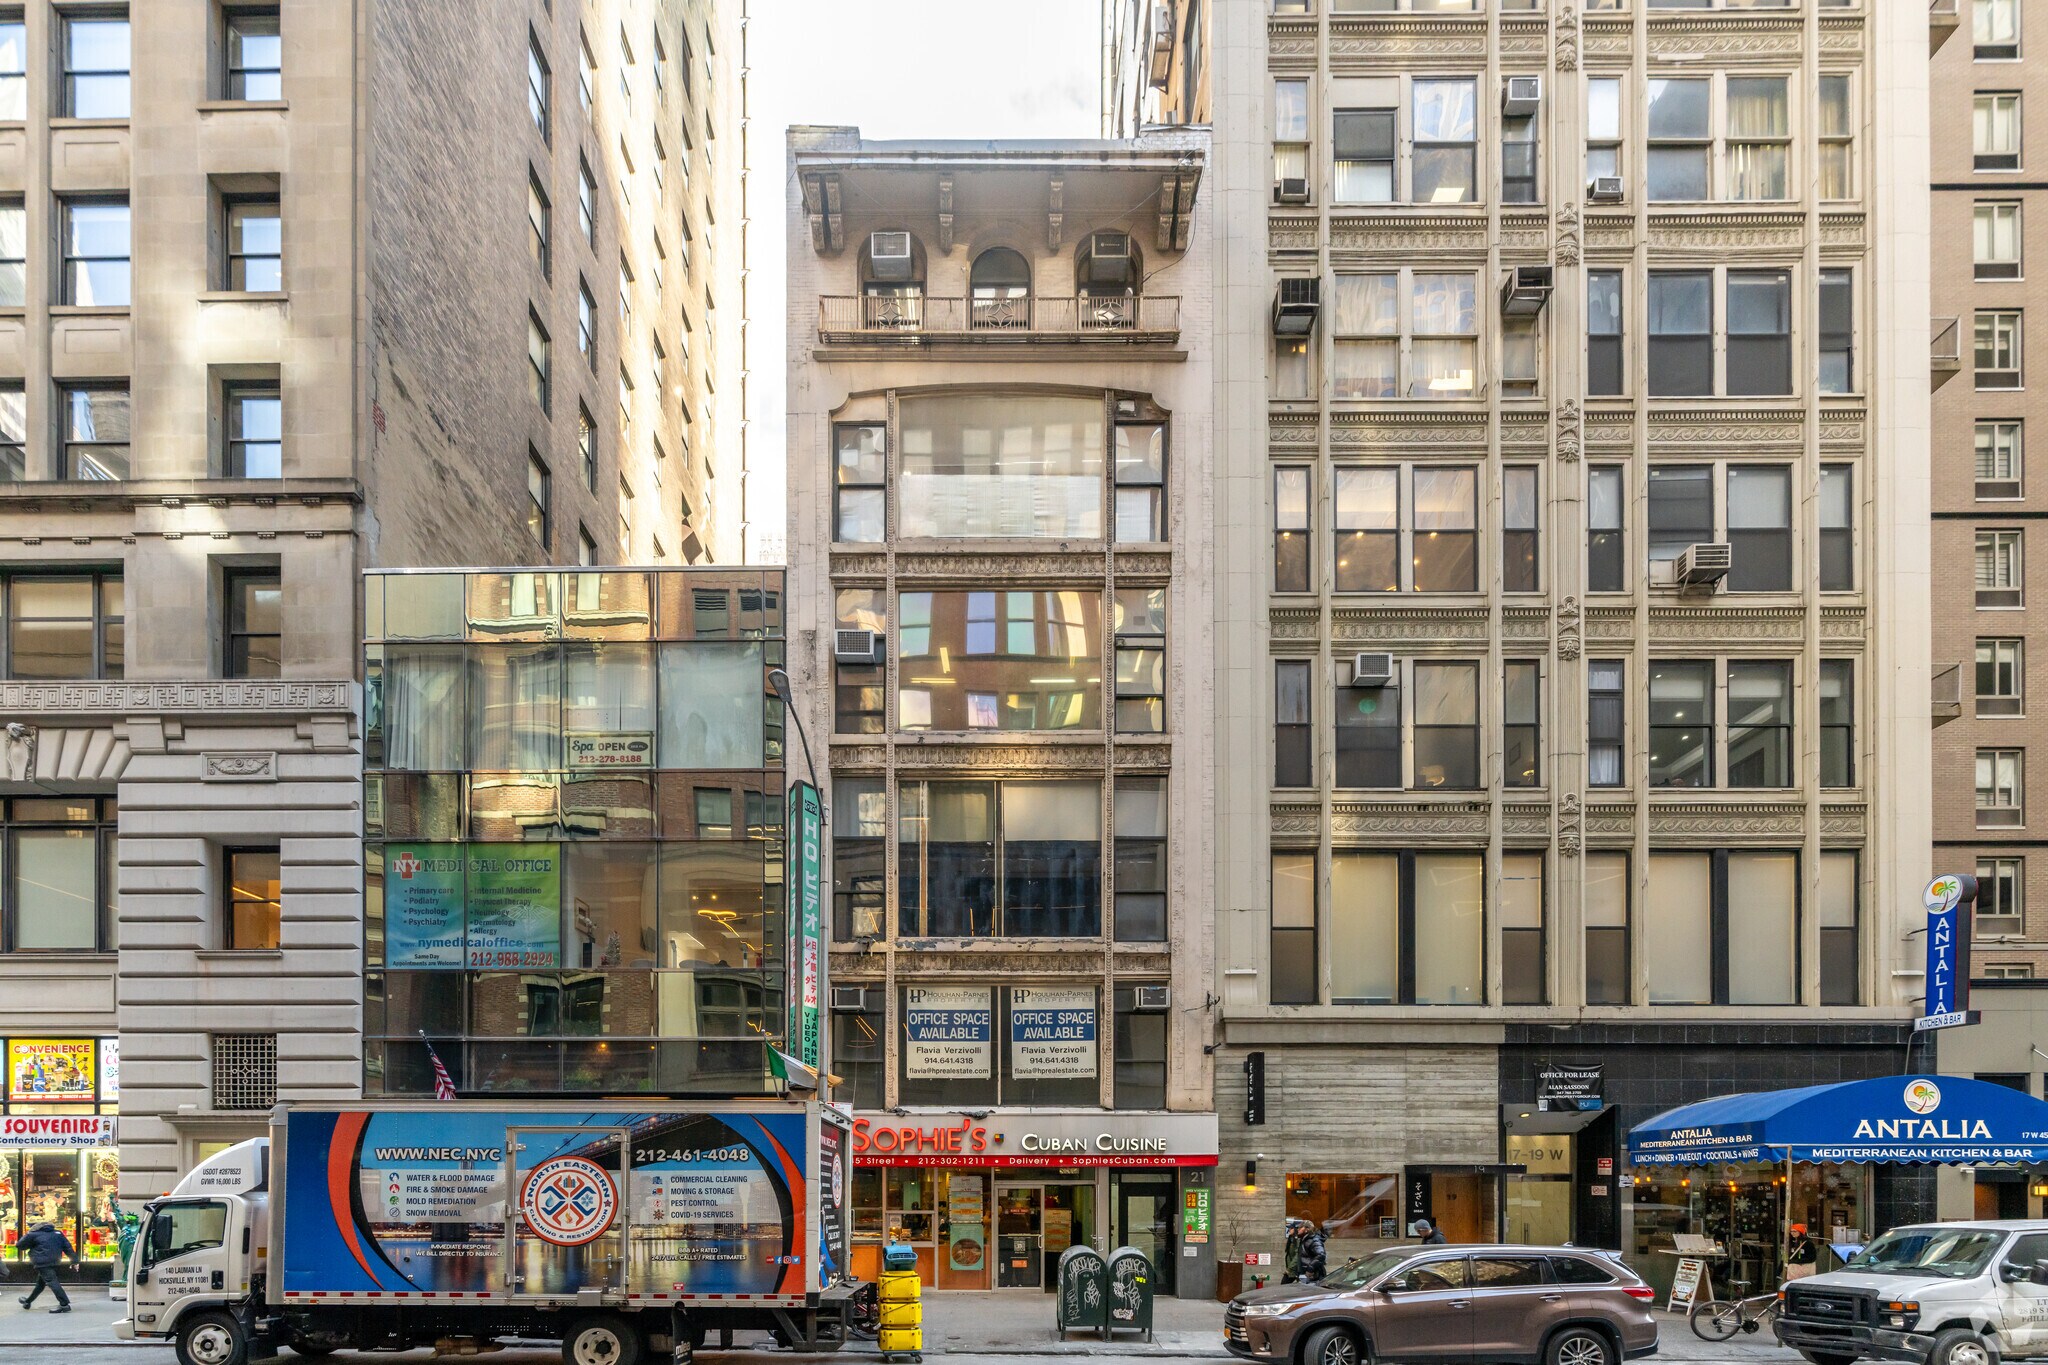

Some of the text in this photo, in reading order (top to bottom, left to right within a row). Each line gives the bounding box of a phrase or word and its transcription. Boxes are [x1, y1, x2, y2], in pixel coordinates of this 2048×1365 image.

[571, 740, 625, 754] Spa OPEN
[579, 755, 642, 763] 212-278-8188
[804, 818, 817, 863] HQ
[393, 859, 551, 872] NY MEDICAL OFFICE
[409, 887, 437, 895] Primary
[409, 897, 439, 905] Podiatry
[474, 898, 504, 906] Physical
[408, 908, 449, 916] Psychology
[474, 908, 510, 917] Neurology
[408, 918, 447, 927] Psychiatry
[473, 919, 516, 927] Dermatology
[473, 927, 498, 935] Allergy
[471, 952, 554, 967] 212-988-2924
[1933, 917, 1950, 1015] ANTALIA
[909, 1013, 989, 1025] OFFICE SPACE
[1013, 1012, 1093, 1025] OFFICE SPACE
[1919, 1014, 1961, 1029] KITCHEN & BAR
[918, 1027, 979, 1039] AVAILABLE
[1023, 1027, 1084, 1039] AVAILABLE
[916, 1046, 982, 1054] Flavia Verzivolli
[1021, 1046, 1087, 1054] Flavia Verzivolli
[909, 1067, 989, 1075] flavia@hprealestate.com
[1014, 1067, 1094, 1075] flavia@hprealestate.com
[5, 1119, 99, 1134] SOUVENIRS
[1853, 1119, 1993, 1139] ANTALIA
[852, 1119, 986, 1152] SOPHIE'S
[1021, 1133, 1087, 1151] CUBAN
[1095, 1134, 1167, 1151] CUISINE
[1671, 1128, 1713, 1140] ANTALIA
[70, 1136, 96, 1146] Shop
[1640, 1138, 1695, 1149] MEDITERRANEAN
[1696, 1137, 1728, 1145] KITCHEN
[375, 1148, 501, 1161] WWW.NEC.NYC
[635, 1149, 750, 1162] 212-461-4048
[1509, 1149, 1563, 1160] 17-19 W
[1635, 1151, 1737, 1163] LUNCH DINNER TAKEOUT COCKTAILS
[1812, 1149, 2033, 1158] MEDITERRANEAN KITCHEN & BAR
[1009, 1157, 1050, 1165] Delivery
[1072, 1157, 1176, 1165] SophiesCuban.com
[1474, 1165, 1485, 1173] 19
[406, 1174, 495, 1182] WATER & FLOOD DAMAGE
[527, 1161, 610, 1198] NORTH EASTERN
[670, 1175, 748, 1184] COMMERCIAL CLEANING
[1190, 1172, 1205, 1182] 21
[457, 1186, 488, 1194] DAMAGE
[406, 1209, 462, 1217] SNOW REMOVAL
[671, 1211, 734, 1219] COVID-19 SERVICES
[529, 1209, 557, 1237] CLEANING
[566, 1209, 608, 1239] RESTORATION
[168, 1287, 200, 1295] 212-461-4048
